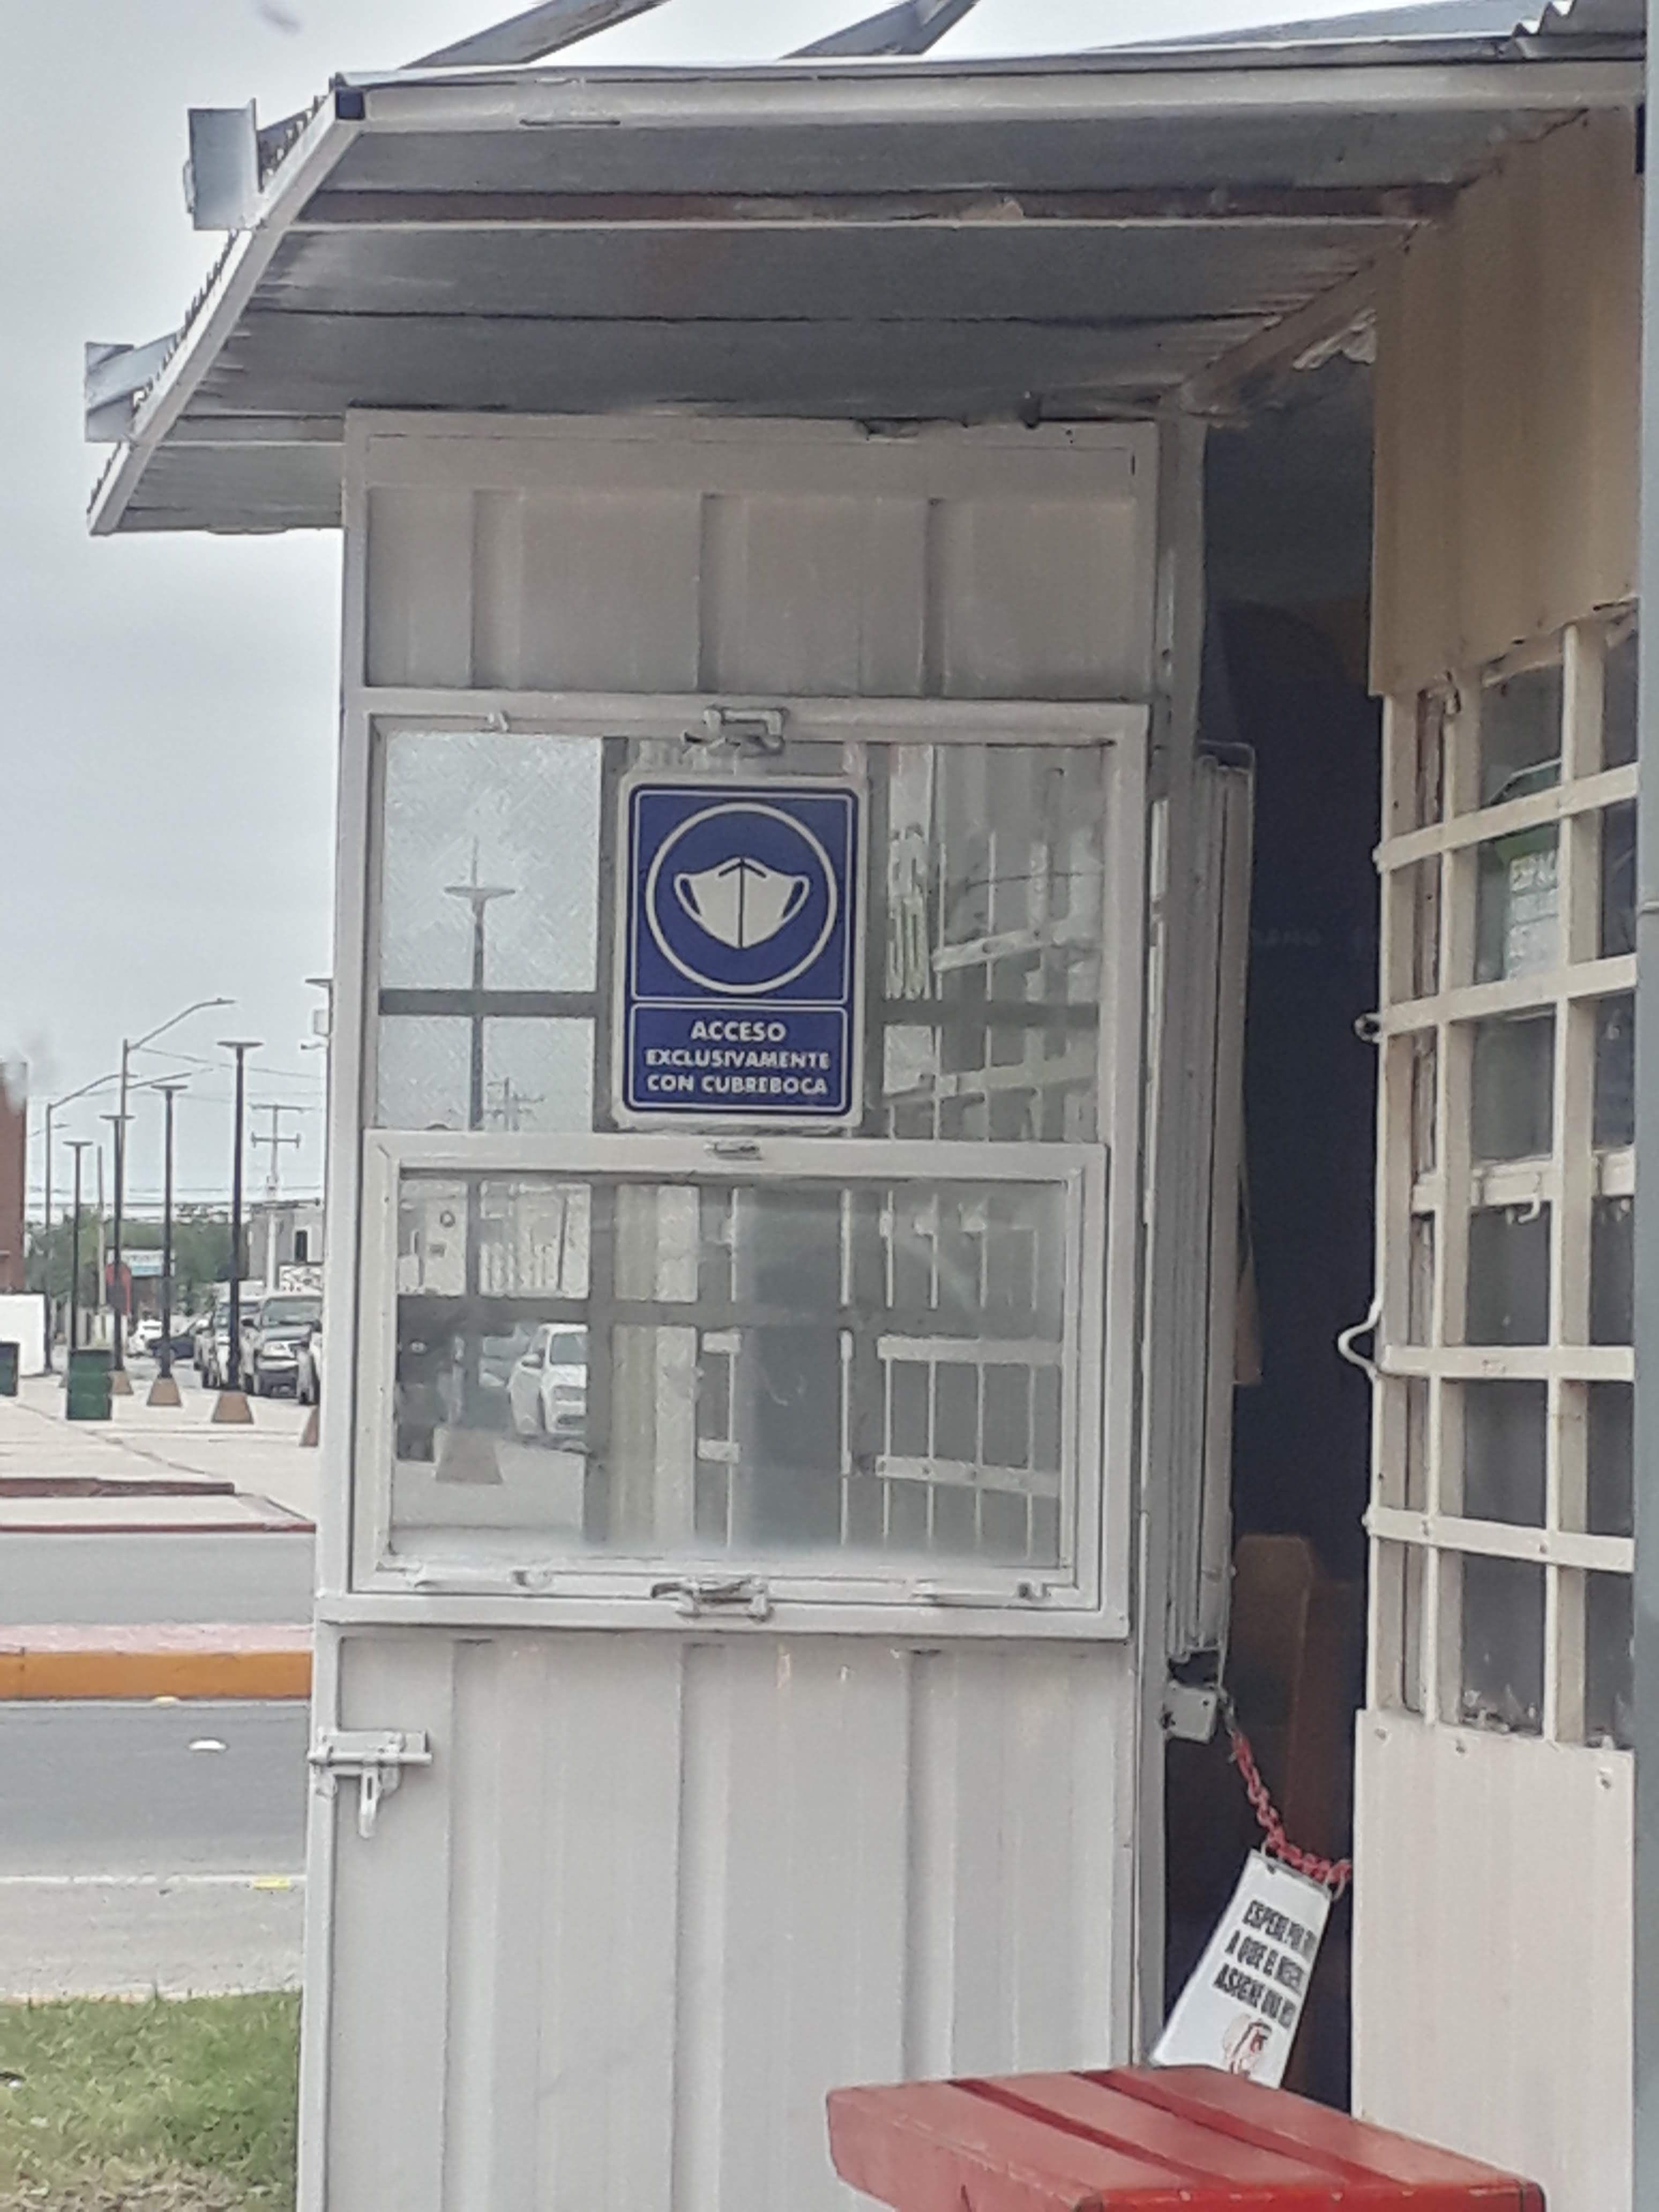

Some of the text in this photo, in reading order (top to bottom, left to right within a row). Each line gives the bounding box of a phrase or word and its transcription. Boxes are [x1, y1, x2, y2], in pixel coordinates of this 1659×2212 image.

[691, 1021, 786, 1042] ACCESO
[646, 1049, 829, 1069] EXCLUSIVAMENTE
[647, 1074, 828, 1095] CON CUBREBOCA
